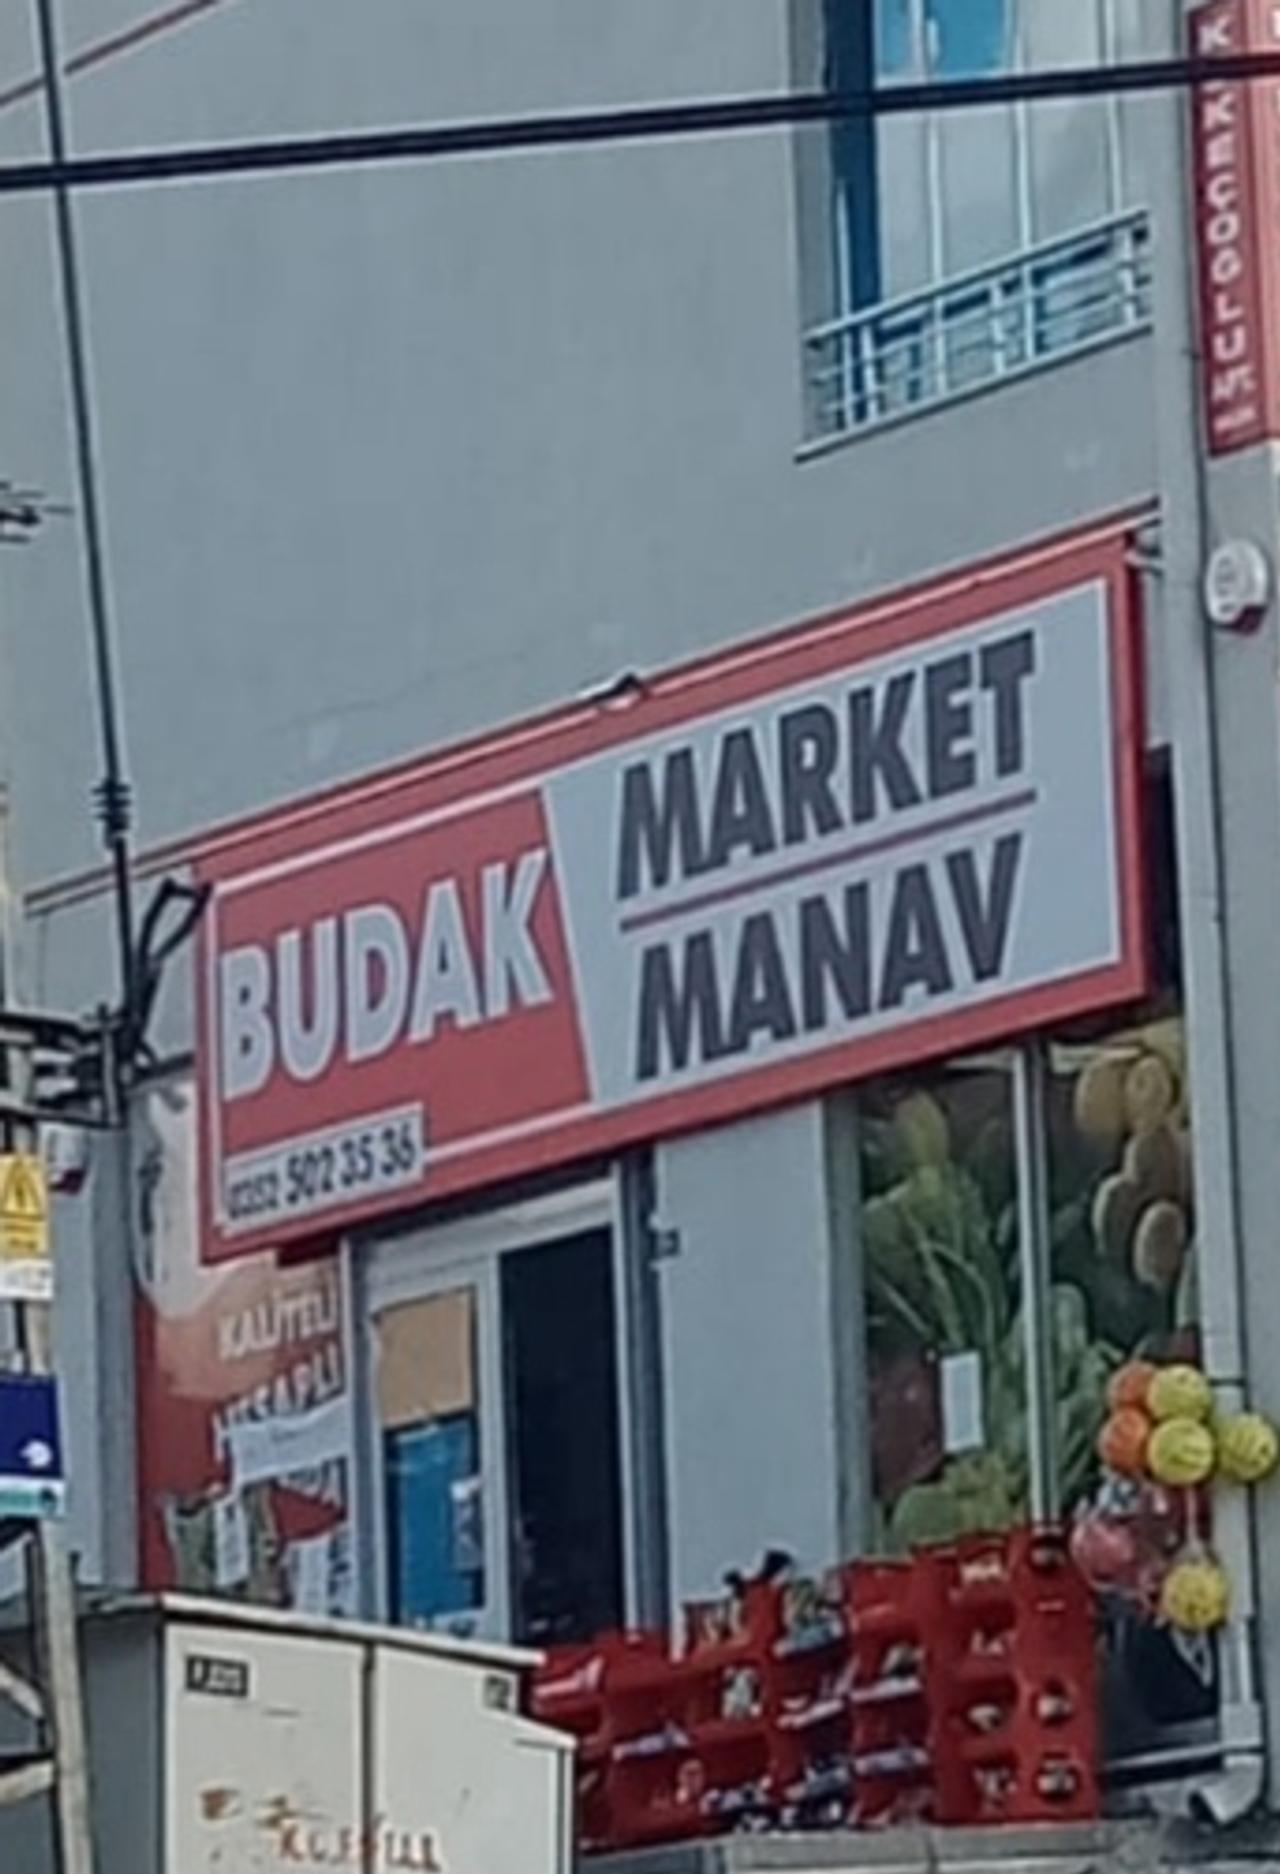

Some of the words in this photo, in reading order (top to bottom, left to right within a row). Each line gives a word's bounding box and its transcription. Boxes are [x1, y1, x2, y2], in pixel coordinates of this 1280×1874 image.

[616, 629, 1036, 901] MARKET
[220, 846, 554, 1104] BUDAK
[634, 830, 1021, 1084] MANAV
[287, 1147, 334, 1203] 502
[341, 1133, 374, 1187] 35
[381, 1123, 416, 1175] 36
